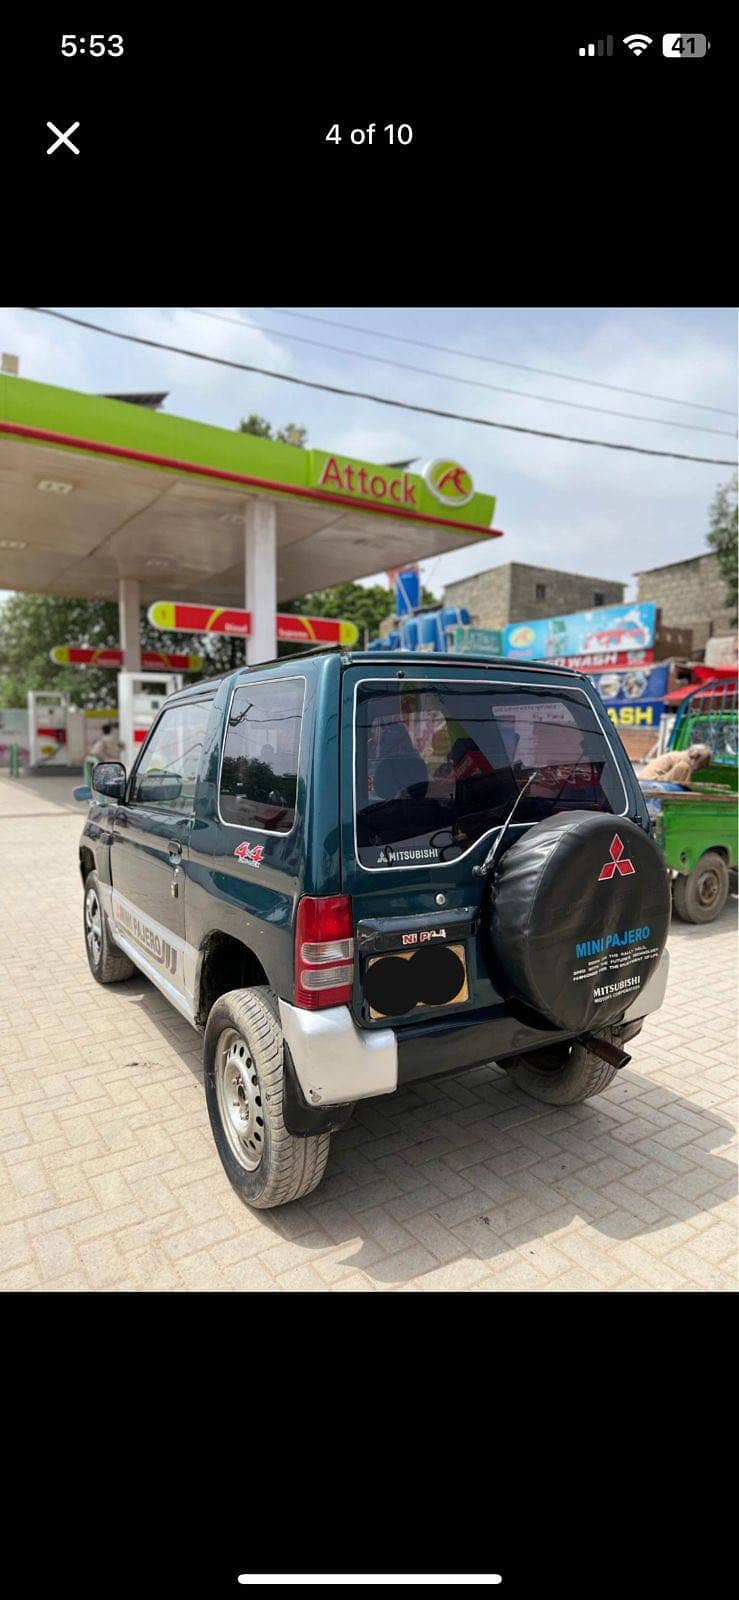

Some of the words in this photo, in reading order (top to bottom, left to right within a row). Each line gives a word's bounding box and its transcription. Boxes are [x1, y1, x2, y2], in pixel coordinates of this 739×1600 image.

[320, 456, 417, 505] Attock
[389, 848, 438, 862] MITSUBISHI
[133, 917, 161, 956] PAJERO
[576, 936, 604, 959] MINI
[605, 926, 650, 949] PAJERO
[593, 975, 641, 998] MITSUBISHI
